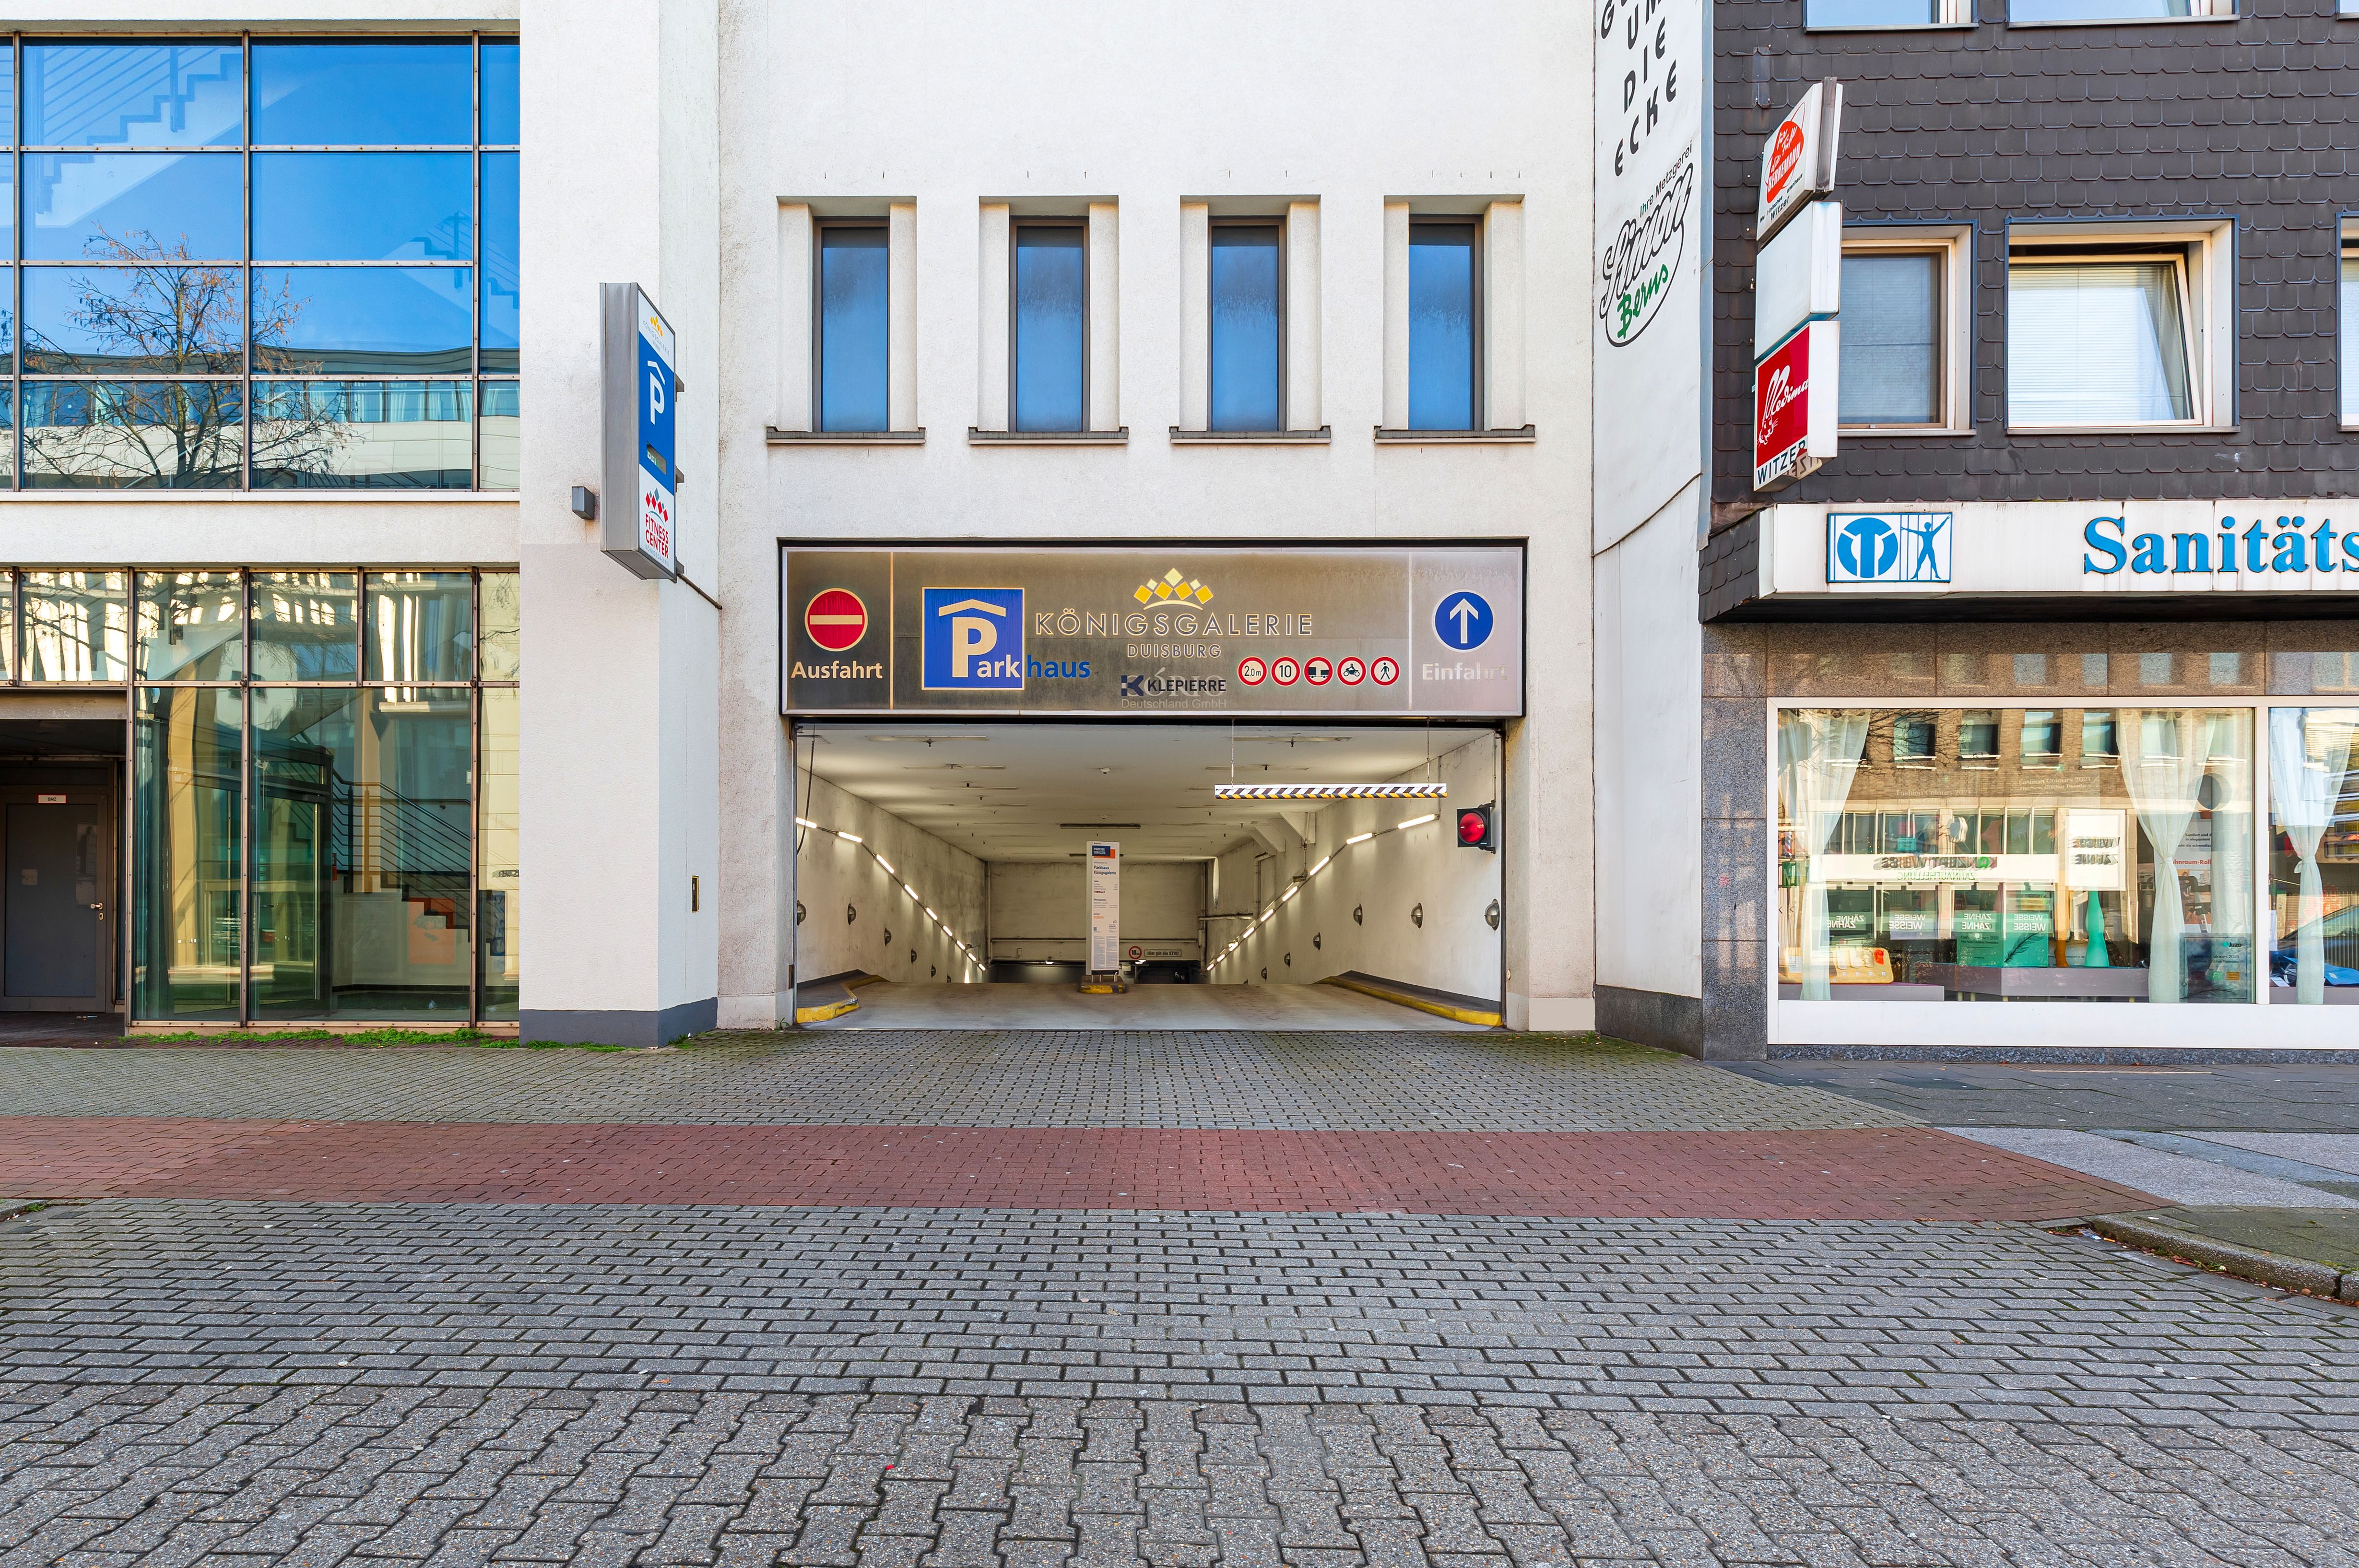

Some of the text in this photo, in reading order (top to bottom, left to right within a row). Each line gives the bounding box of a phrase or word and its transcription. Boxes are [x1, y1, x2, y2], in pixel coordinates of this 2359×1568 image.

[1624, 16, 1665, 114] DIE
[1615, 59, 1676, 176] ECKE
[1640, 139, 1693, 218] Ihre Metzgerei
[1768, 141, 1801, 193] BERKEMANN
[1771, 195, 1790, 221] Witzer
[1617, 263, 1668, 339] Berns
[645, 513, 669, 544] FITNESS
[645, 529, 669, 559] CENTER
[2083, 515, 2359, 574] Sanitäts
[1035, 608, 1312, 636] KÖNIGSGALERIE
[1127, 643, 1221, 659] DUISBURG
[791, 660, 883, 679] Ausfahrt
[1279, 665, 1292, 678] 10
[1423, 662, 1508, 681] Einfahrt
[1148, 680, 1227, 692] KLEPIERRE
[1121, 699, 1227, 708] Deutschland GmbH
